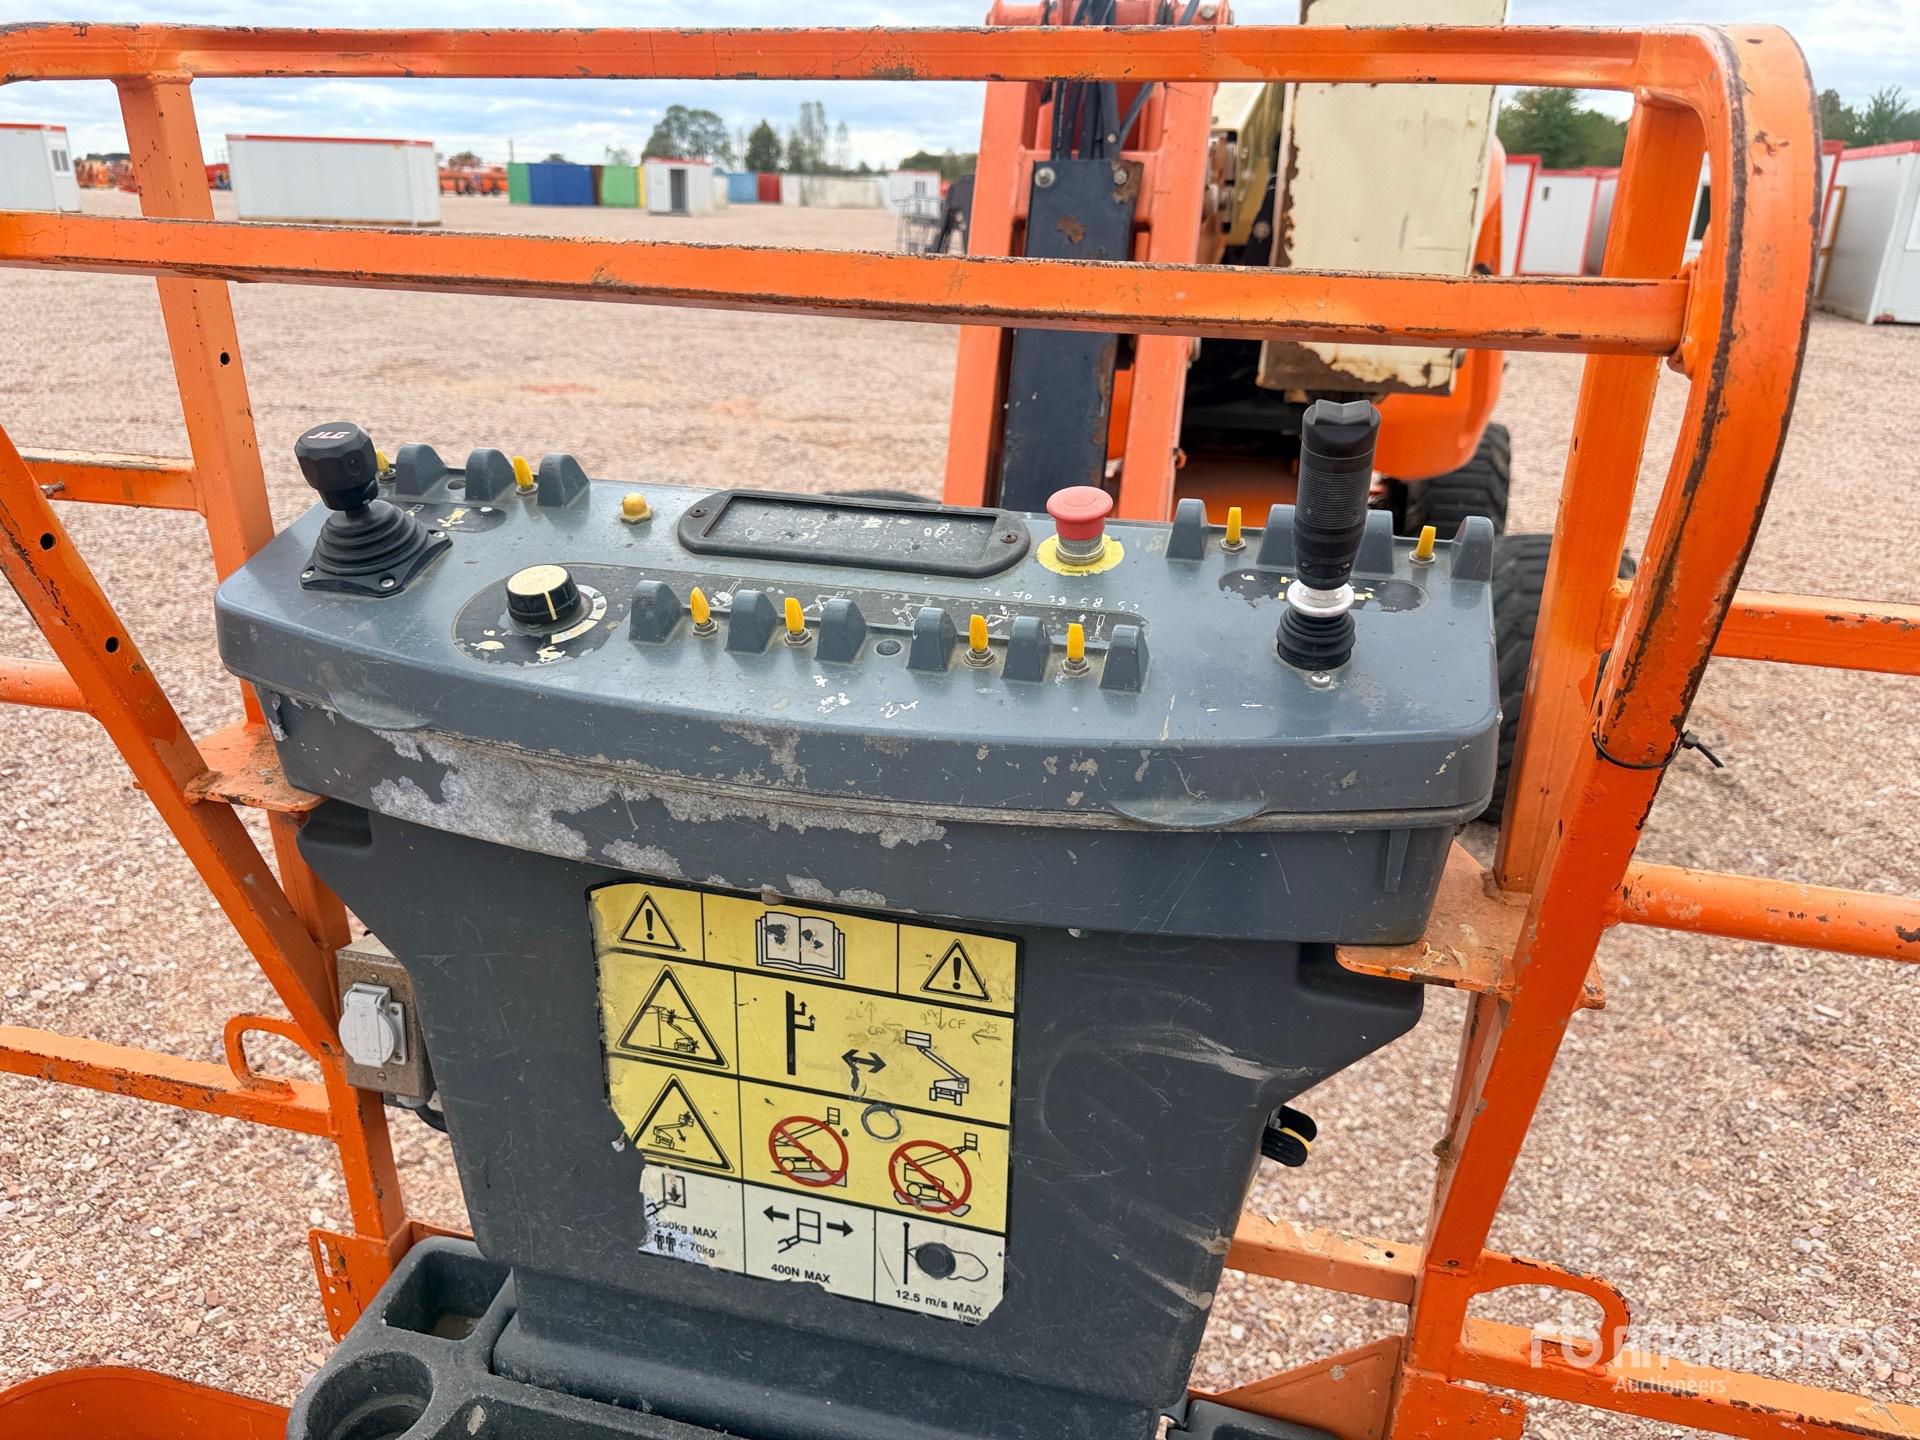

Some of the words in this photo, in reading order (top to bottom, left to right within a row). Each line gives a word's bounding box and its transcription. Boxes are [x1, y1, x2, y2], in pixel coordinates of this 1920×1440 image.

[307, 431, 351, 440] JLG
[692, 1225, 718, 1240] MAX
[689, 1242, 716, 1258] 70kg
[771, 1263, 800, 1278] 400N
[804, 1269, 831, 1284] MAX
[895, 1289, 921, 1303] 12.5
[925, 1296, 948, 1309] m/s
[953, 1301, 982, 1316] MAX
